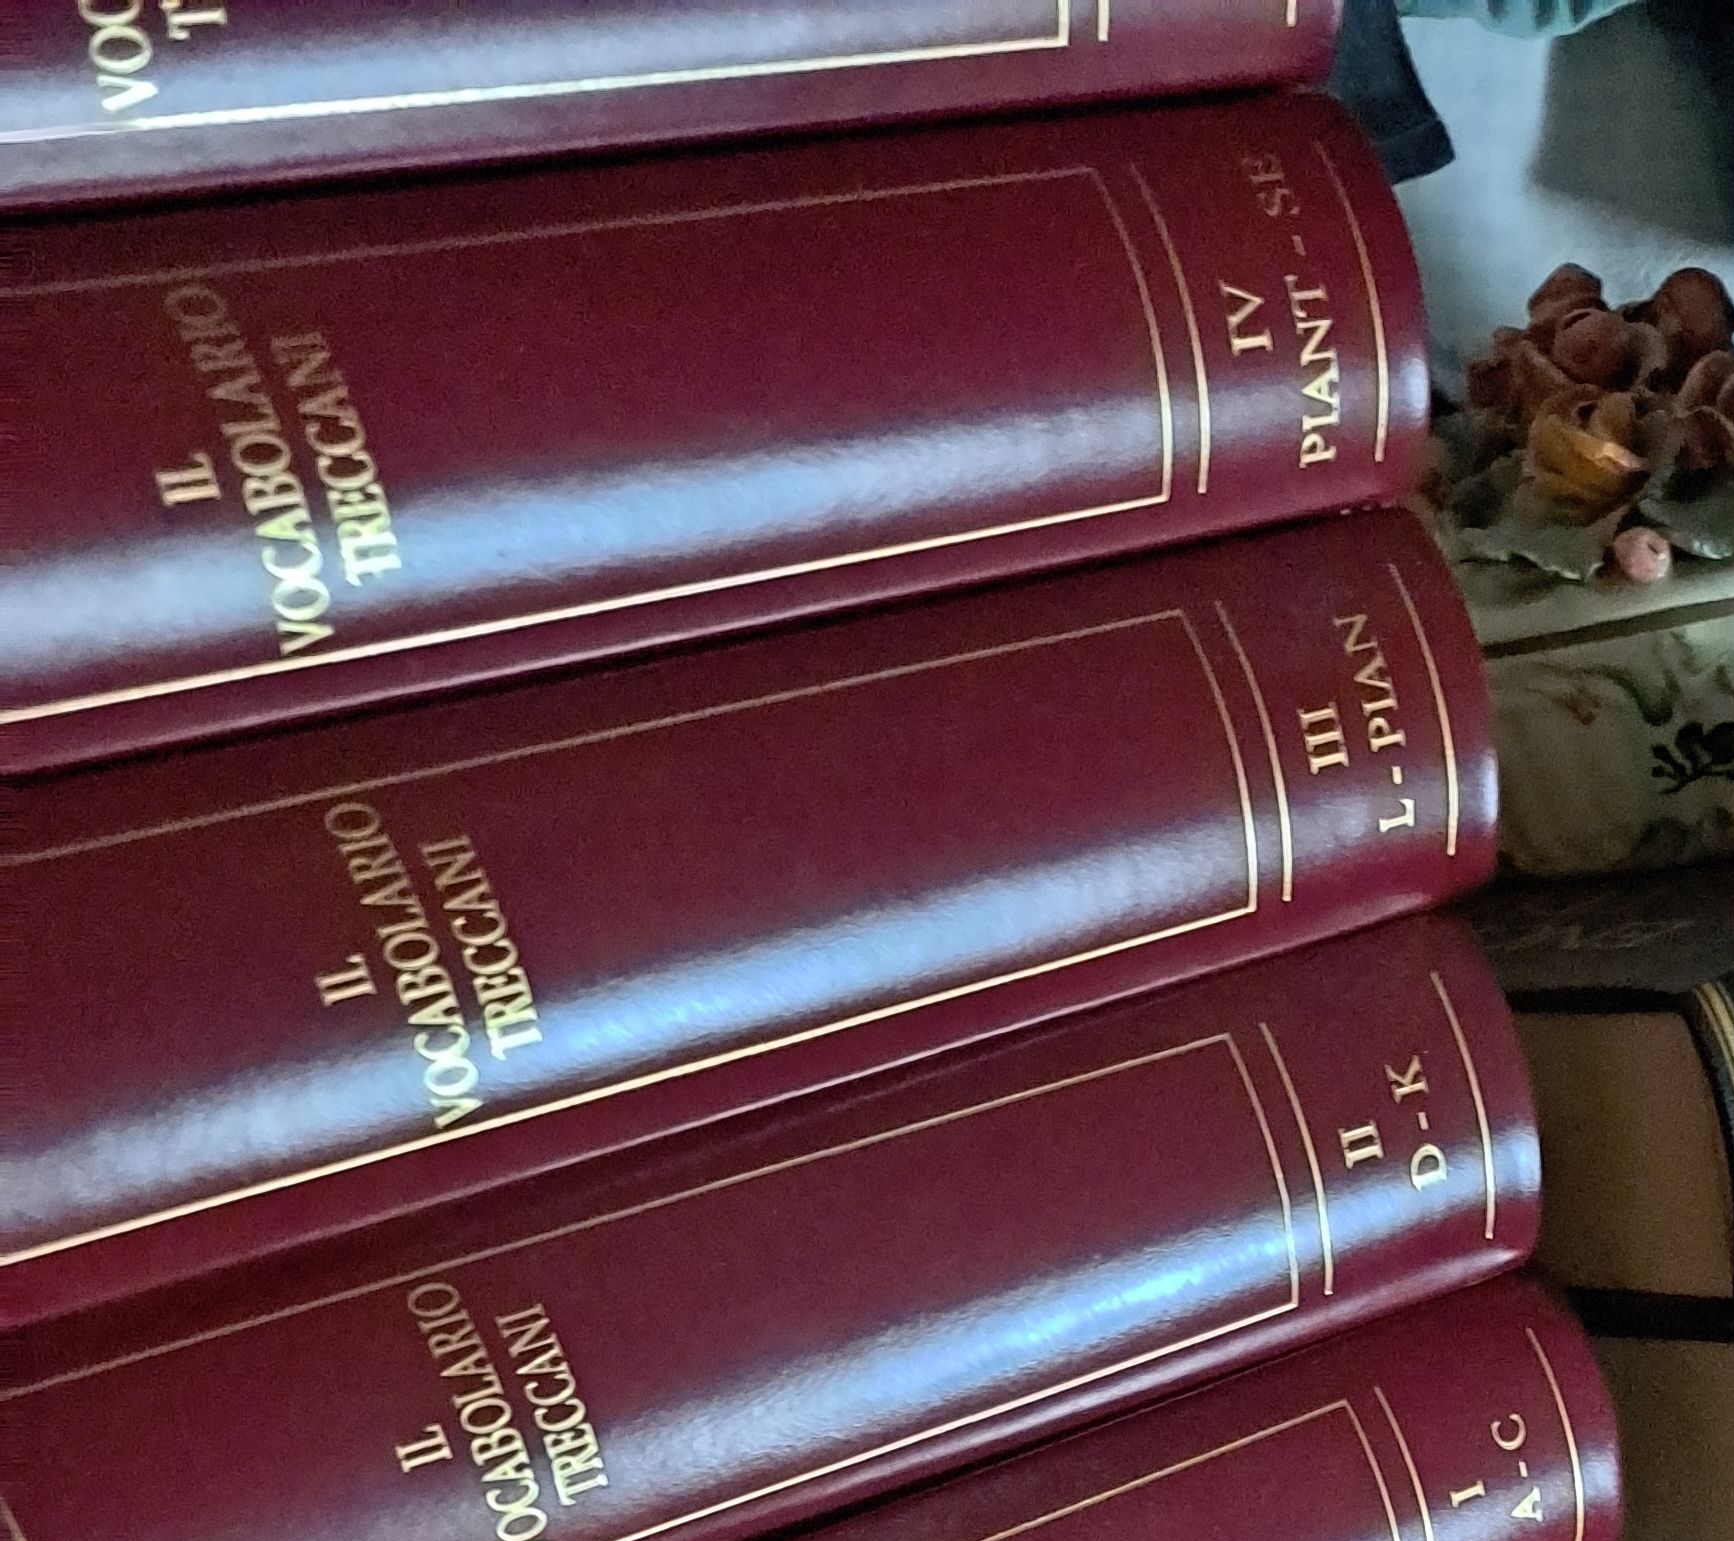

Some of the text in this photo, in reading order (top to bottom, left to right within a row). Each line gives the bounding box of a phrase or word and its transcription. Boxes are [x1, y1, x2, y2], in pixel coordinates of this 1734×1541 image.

[1219, 280, 1273, 354] IV
[155, 449, 222, 508] IL
[164, 285, 333, 655] VOCABOLARIO
[271, 332, 402, 588] TRECCANI
[1333, 613, 1406, 753] PIAN
[1298, 701, 1350, 775] III
[1379, 797, 1415, 832] L
[324, 802, 486, 1131] VOCABOLARIO
[419, 834, 545, 1063] TRECCANI
[314, 953, 378, 1008] IL
[1385, 1055, 1430, 1104] K
[1337, 1121, 1385, 1169] II
[1410, 1142, 1447, 1192] D
[495, 1302, 610, 1506] TRECCANI
[1490, 1412, 1527, 1452] C
[396, 1424, 452, 1475] IL
[1450, 1479, 1487, 1508] I
[1510, 1486, 1543, 1523] A
